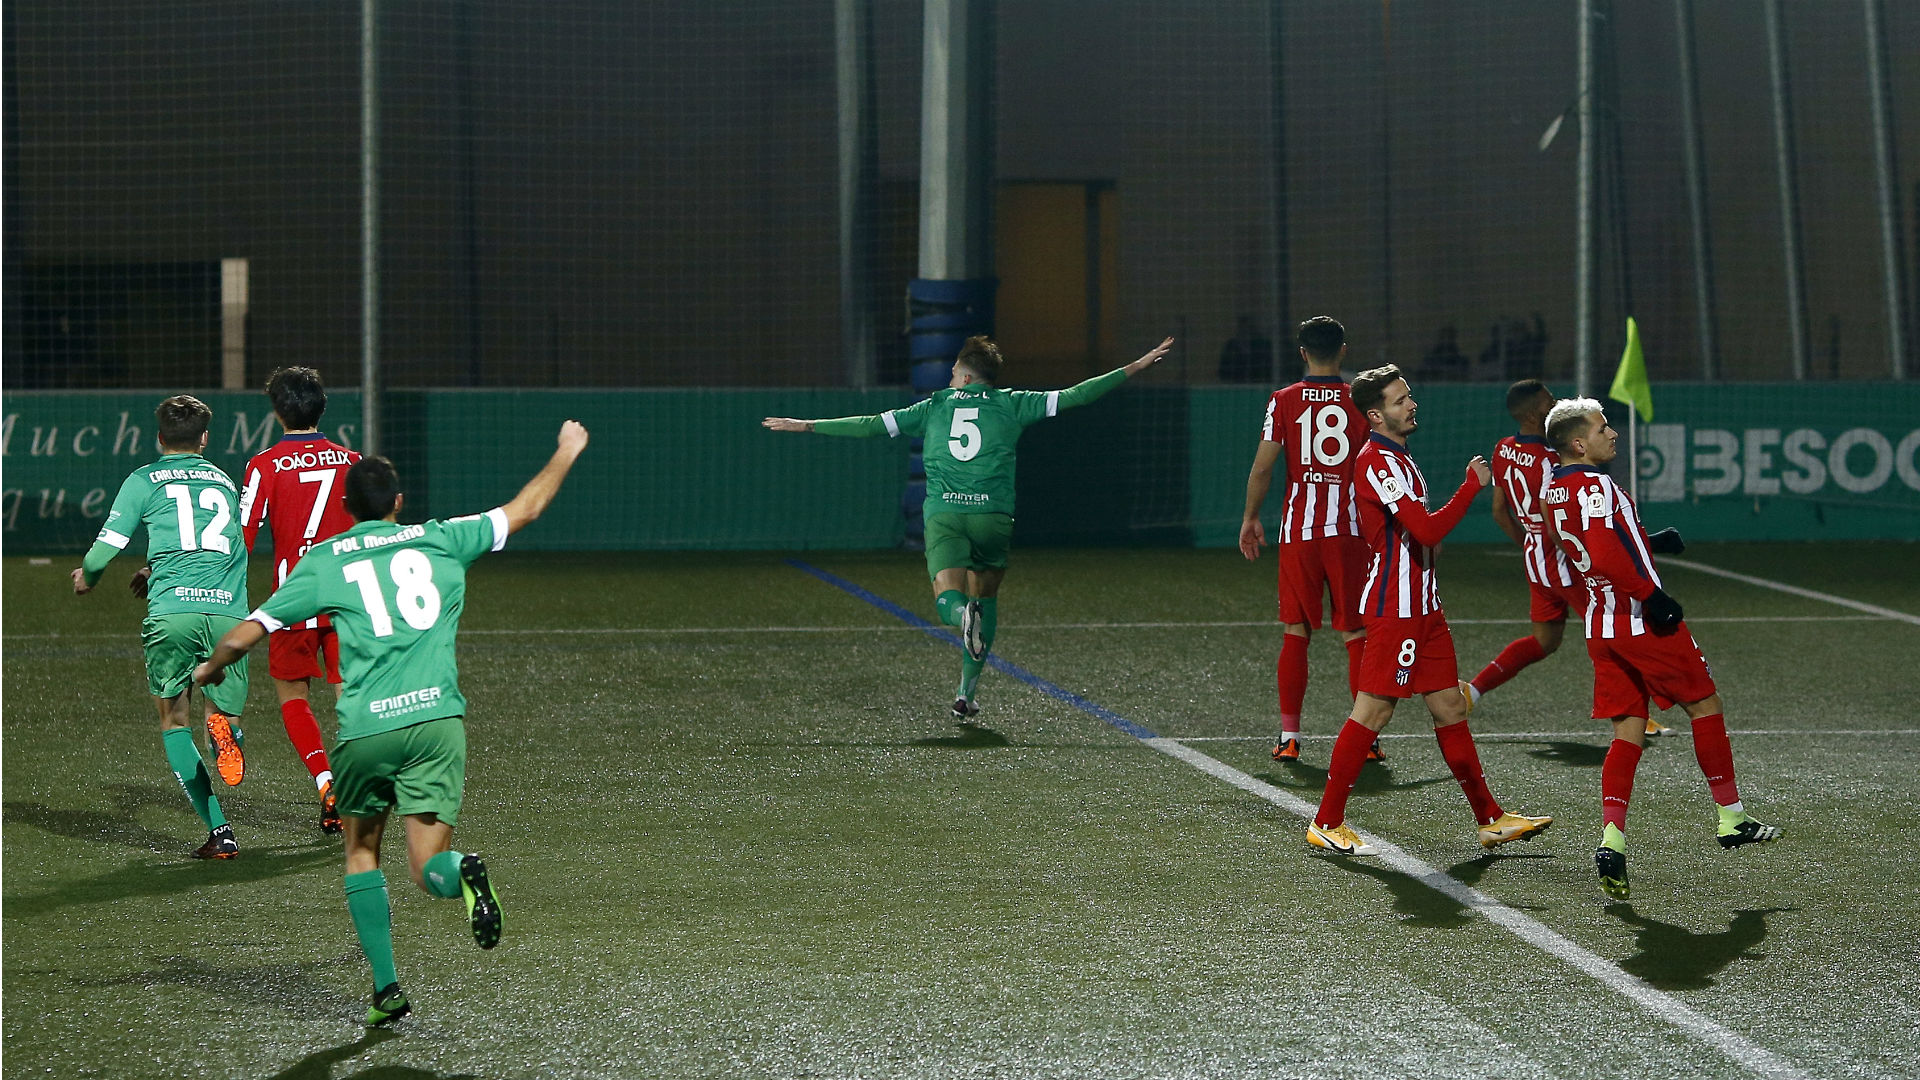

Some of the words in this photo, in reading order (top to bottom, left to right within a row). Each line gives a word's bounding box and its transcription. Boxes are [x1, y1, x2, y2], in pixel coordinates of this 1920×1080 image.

[1302, 388, 1341, 402] FELIPE
[948, 407, 982, 462] 5
[1295, 404, 1350, 466] 18
[272, 452, 317, 473] JOÃO
[317, 448, 352, 467] FÉLIX
[1303, 466, 1323, 482] ria
[1694, 427, 1920, 495] BESO
[149, 469, 188, 484] CARLOS
[298, 468, 337, 539] 7
[942, 492, 989, 501] ENINTER
[1503, 464, 1543, 522] 12
[166, 484, 231, 554] 12
[332, 536, 361, 556] POL
[363, 524, 426, 549] MORENO
[1553, 508, 1591, 573] 5
[175, 586, 233, 601] ENINTER
[180, 597, 230, 605] ASCENSORES
[342, 548, 441, 638] 18
[1397, 638, 1416, 667] 8
[369, 686, 441, 713] ENINTER
[378, 700, 437, 719] ASCENSORES
